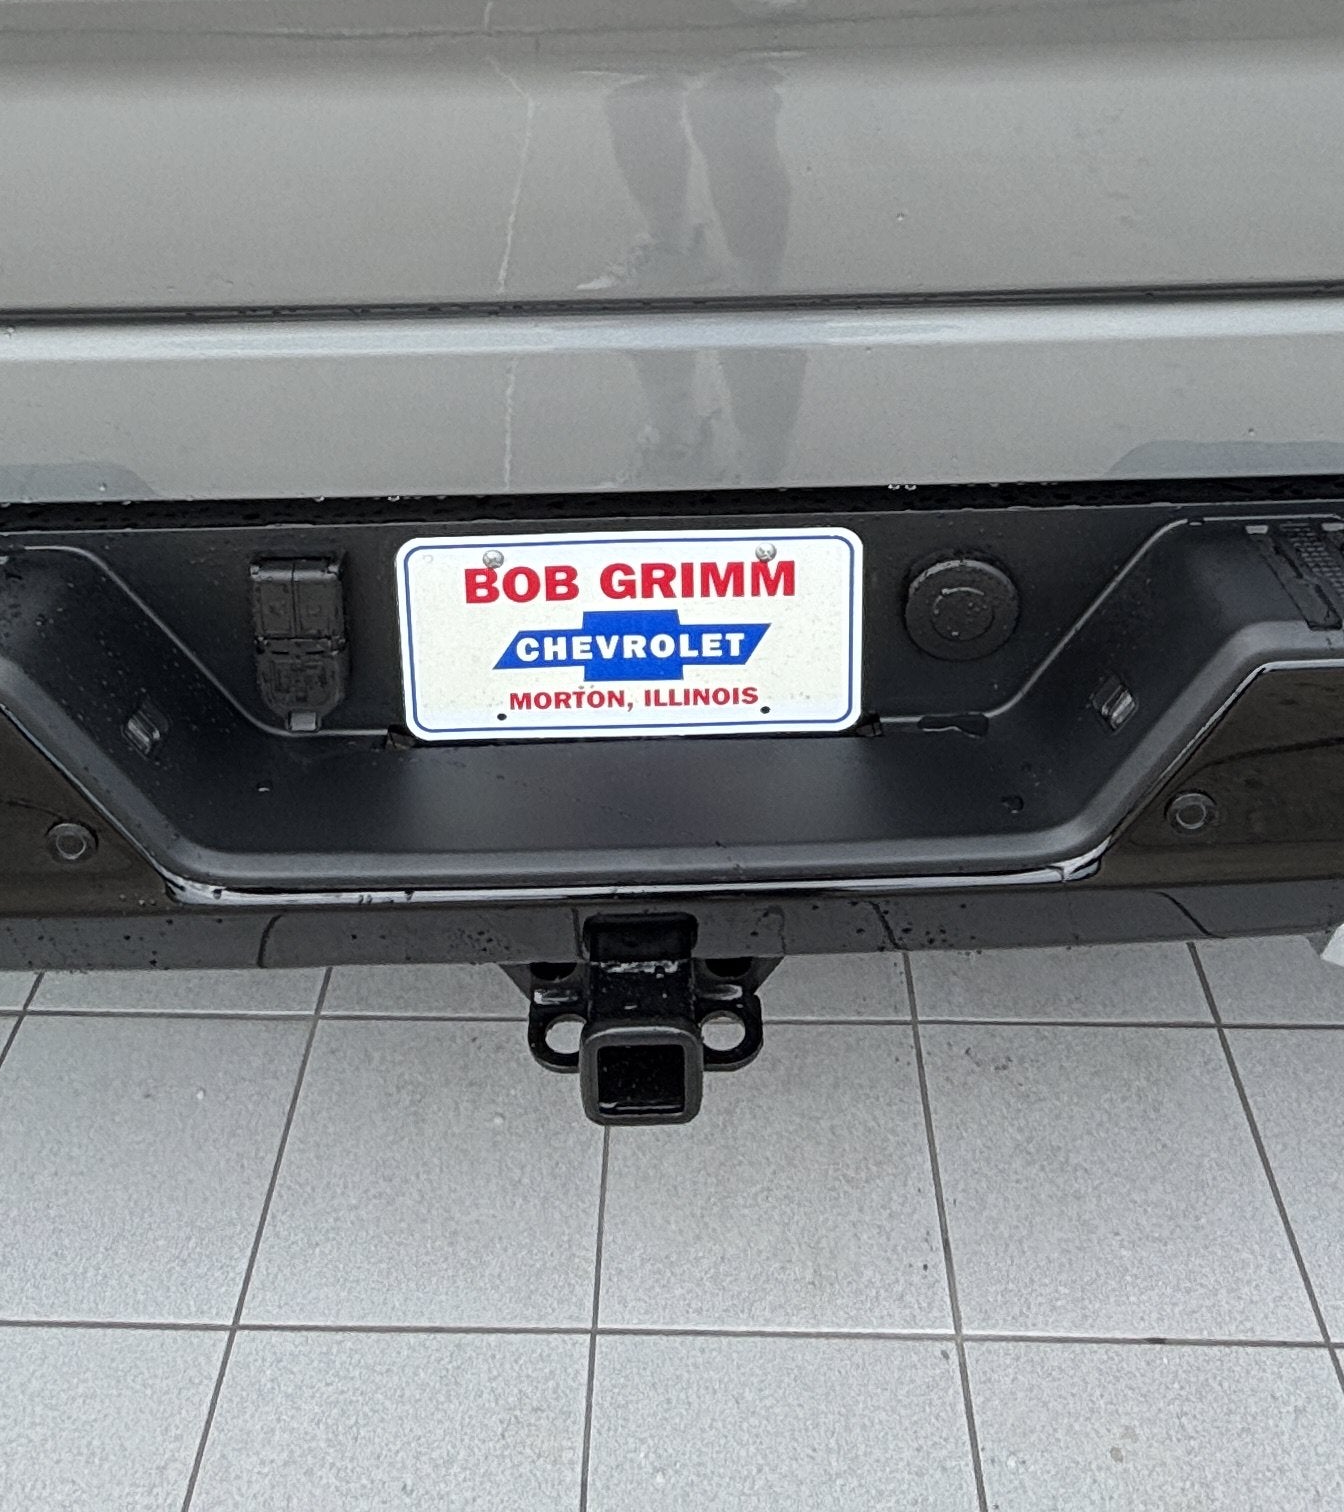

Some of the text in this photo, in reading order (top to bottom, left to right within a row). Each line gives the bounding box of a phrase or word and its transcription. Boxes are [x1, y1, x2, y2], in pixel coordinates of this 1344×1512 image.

[464, 560, 795, 604] BOB GRIMM
[515, 632, 746, 663] CHEVROLET
[509, 686, 759, 712] MORTON, ILLINOIS
